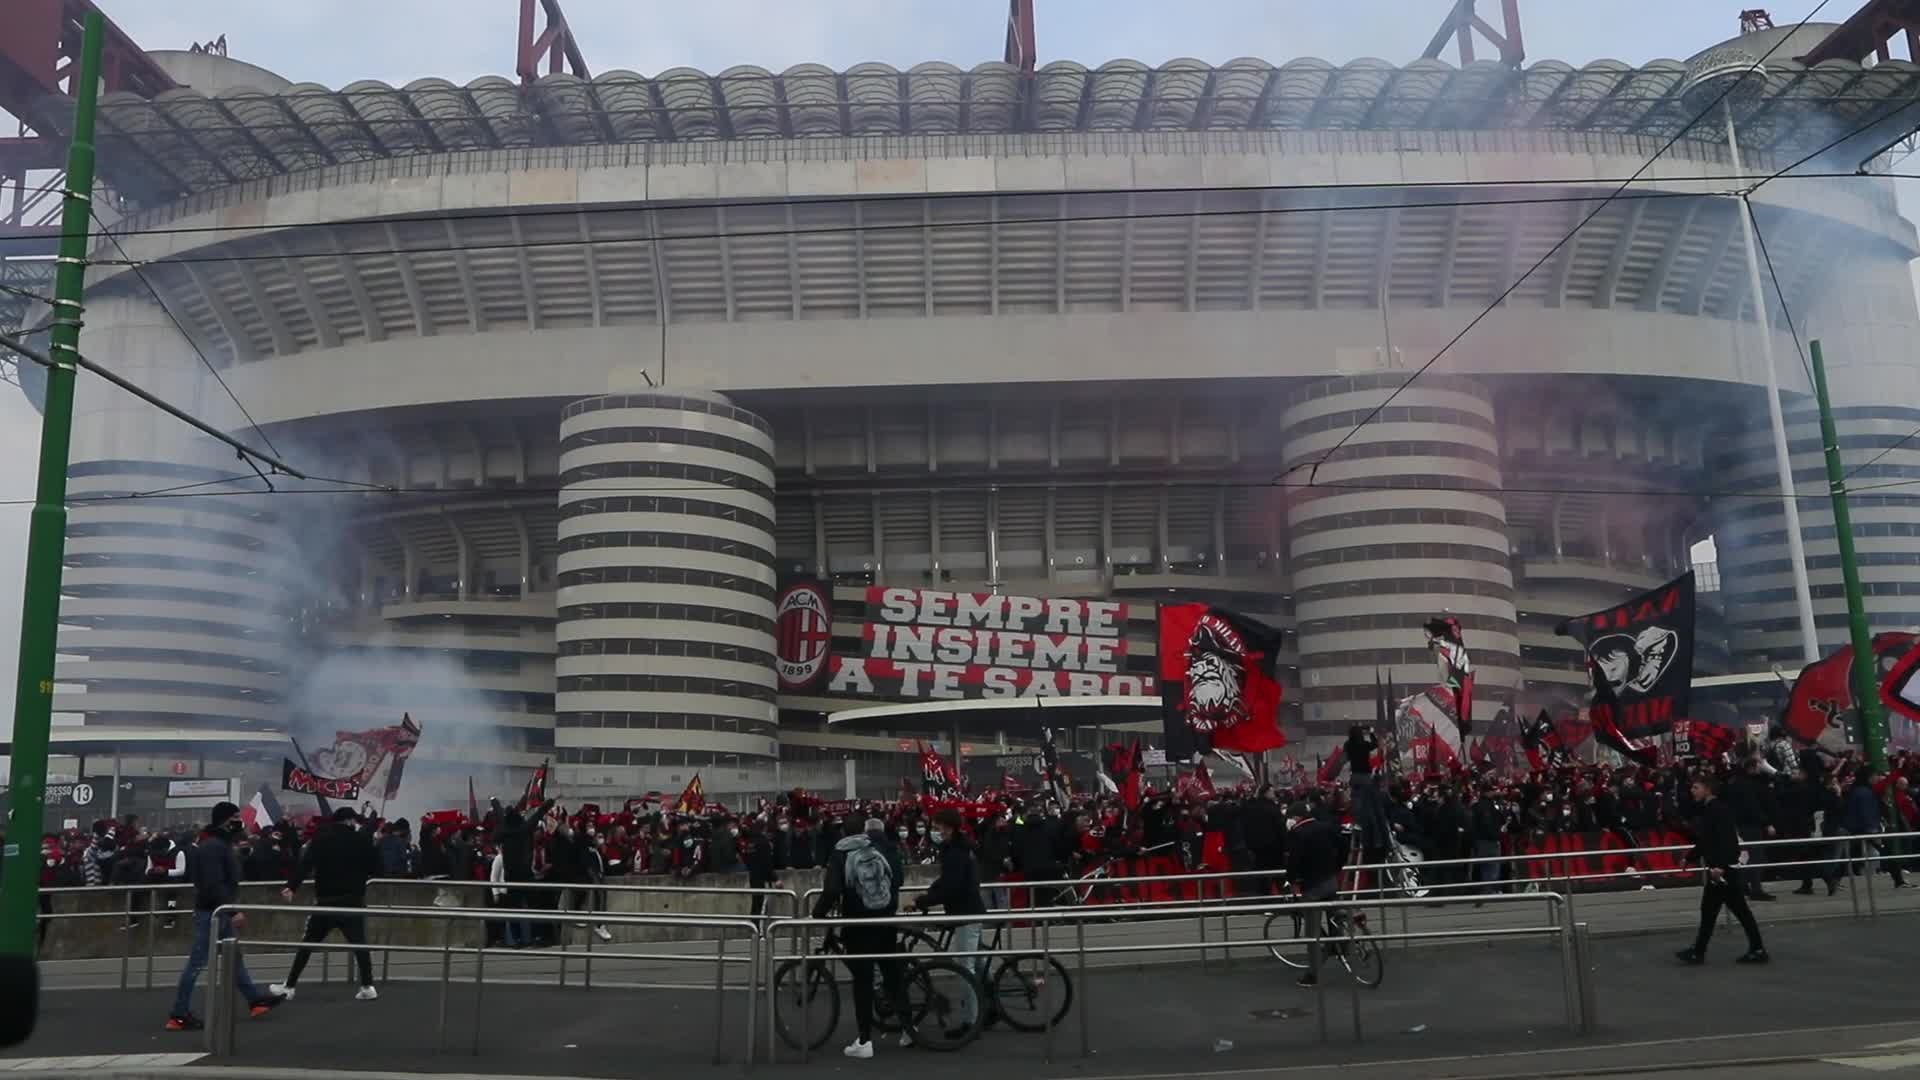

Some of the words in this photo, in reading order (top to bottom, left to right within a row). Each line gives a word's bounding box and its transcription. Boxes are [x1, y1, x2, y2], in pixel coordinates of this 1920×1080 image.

[783, 591, 818, 609] ACM
[880, 588, 1121, 637] SEMPRE
[870, 623, 1120, 673] INSIEME
[782, 653, 813, 676] 1899
[828, 657, 875, 692] A
[893, 661, 967, 699] TE
[76, 786, 91, 802] 13
